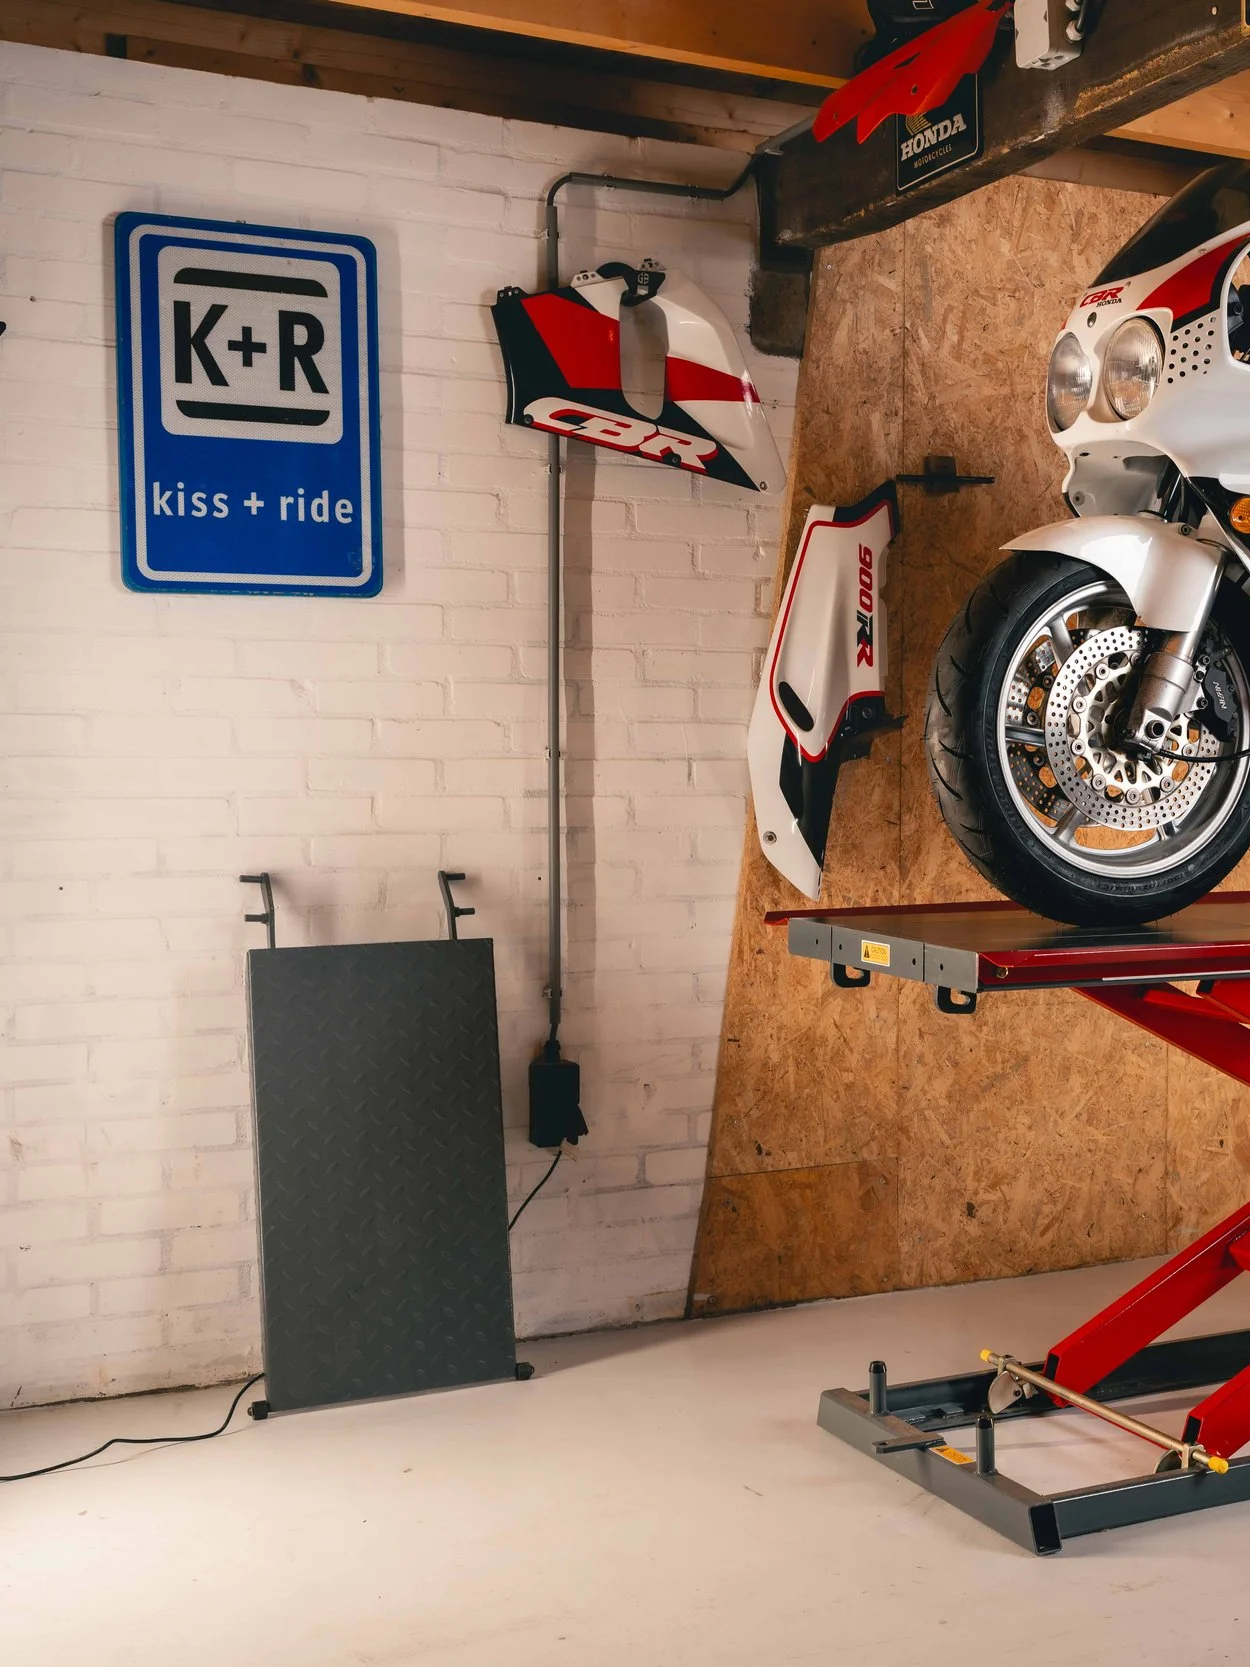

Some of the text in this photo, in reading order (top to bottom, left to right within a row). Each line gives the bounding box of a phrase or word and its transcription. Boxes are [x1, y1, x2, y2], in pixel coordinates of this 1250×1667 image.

[900, 113, 967, 161] HONDA
[913, 143, 952, 169] MOTORCYCLES
[1079, 286, 1124, 308] CBR
[1096, 298, 1122, 308] HONDA
[173, 300, 330, 394] K+R
[523, 397, 719, 474] CBR
[152, 481, 354, 524] kiss + ride
